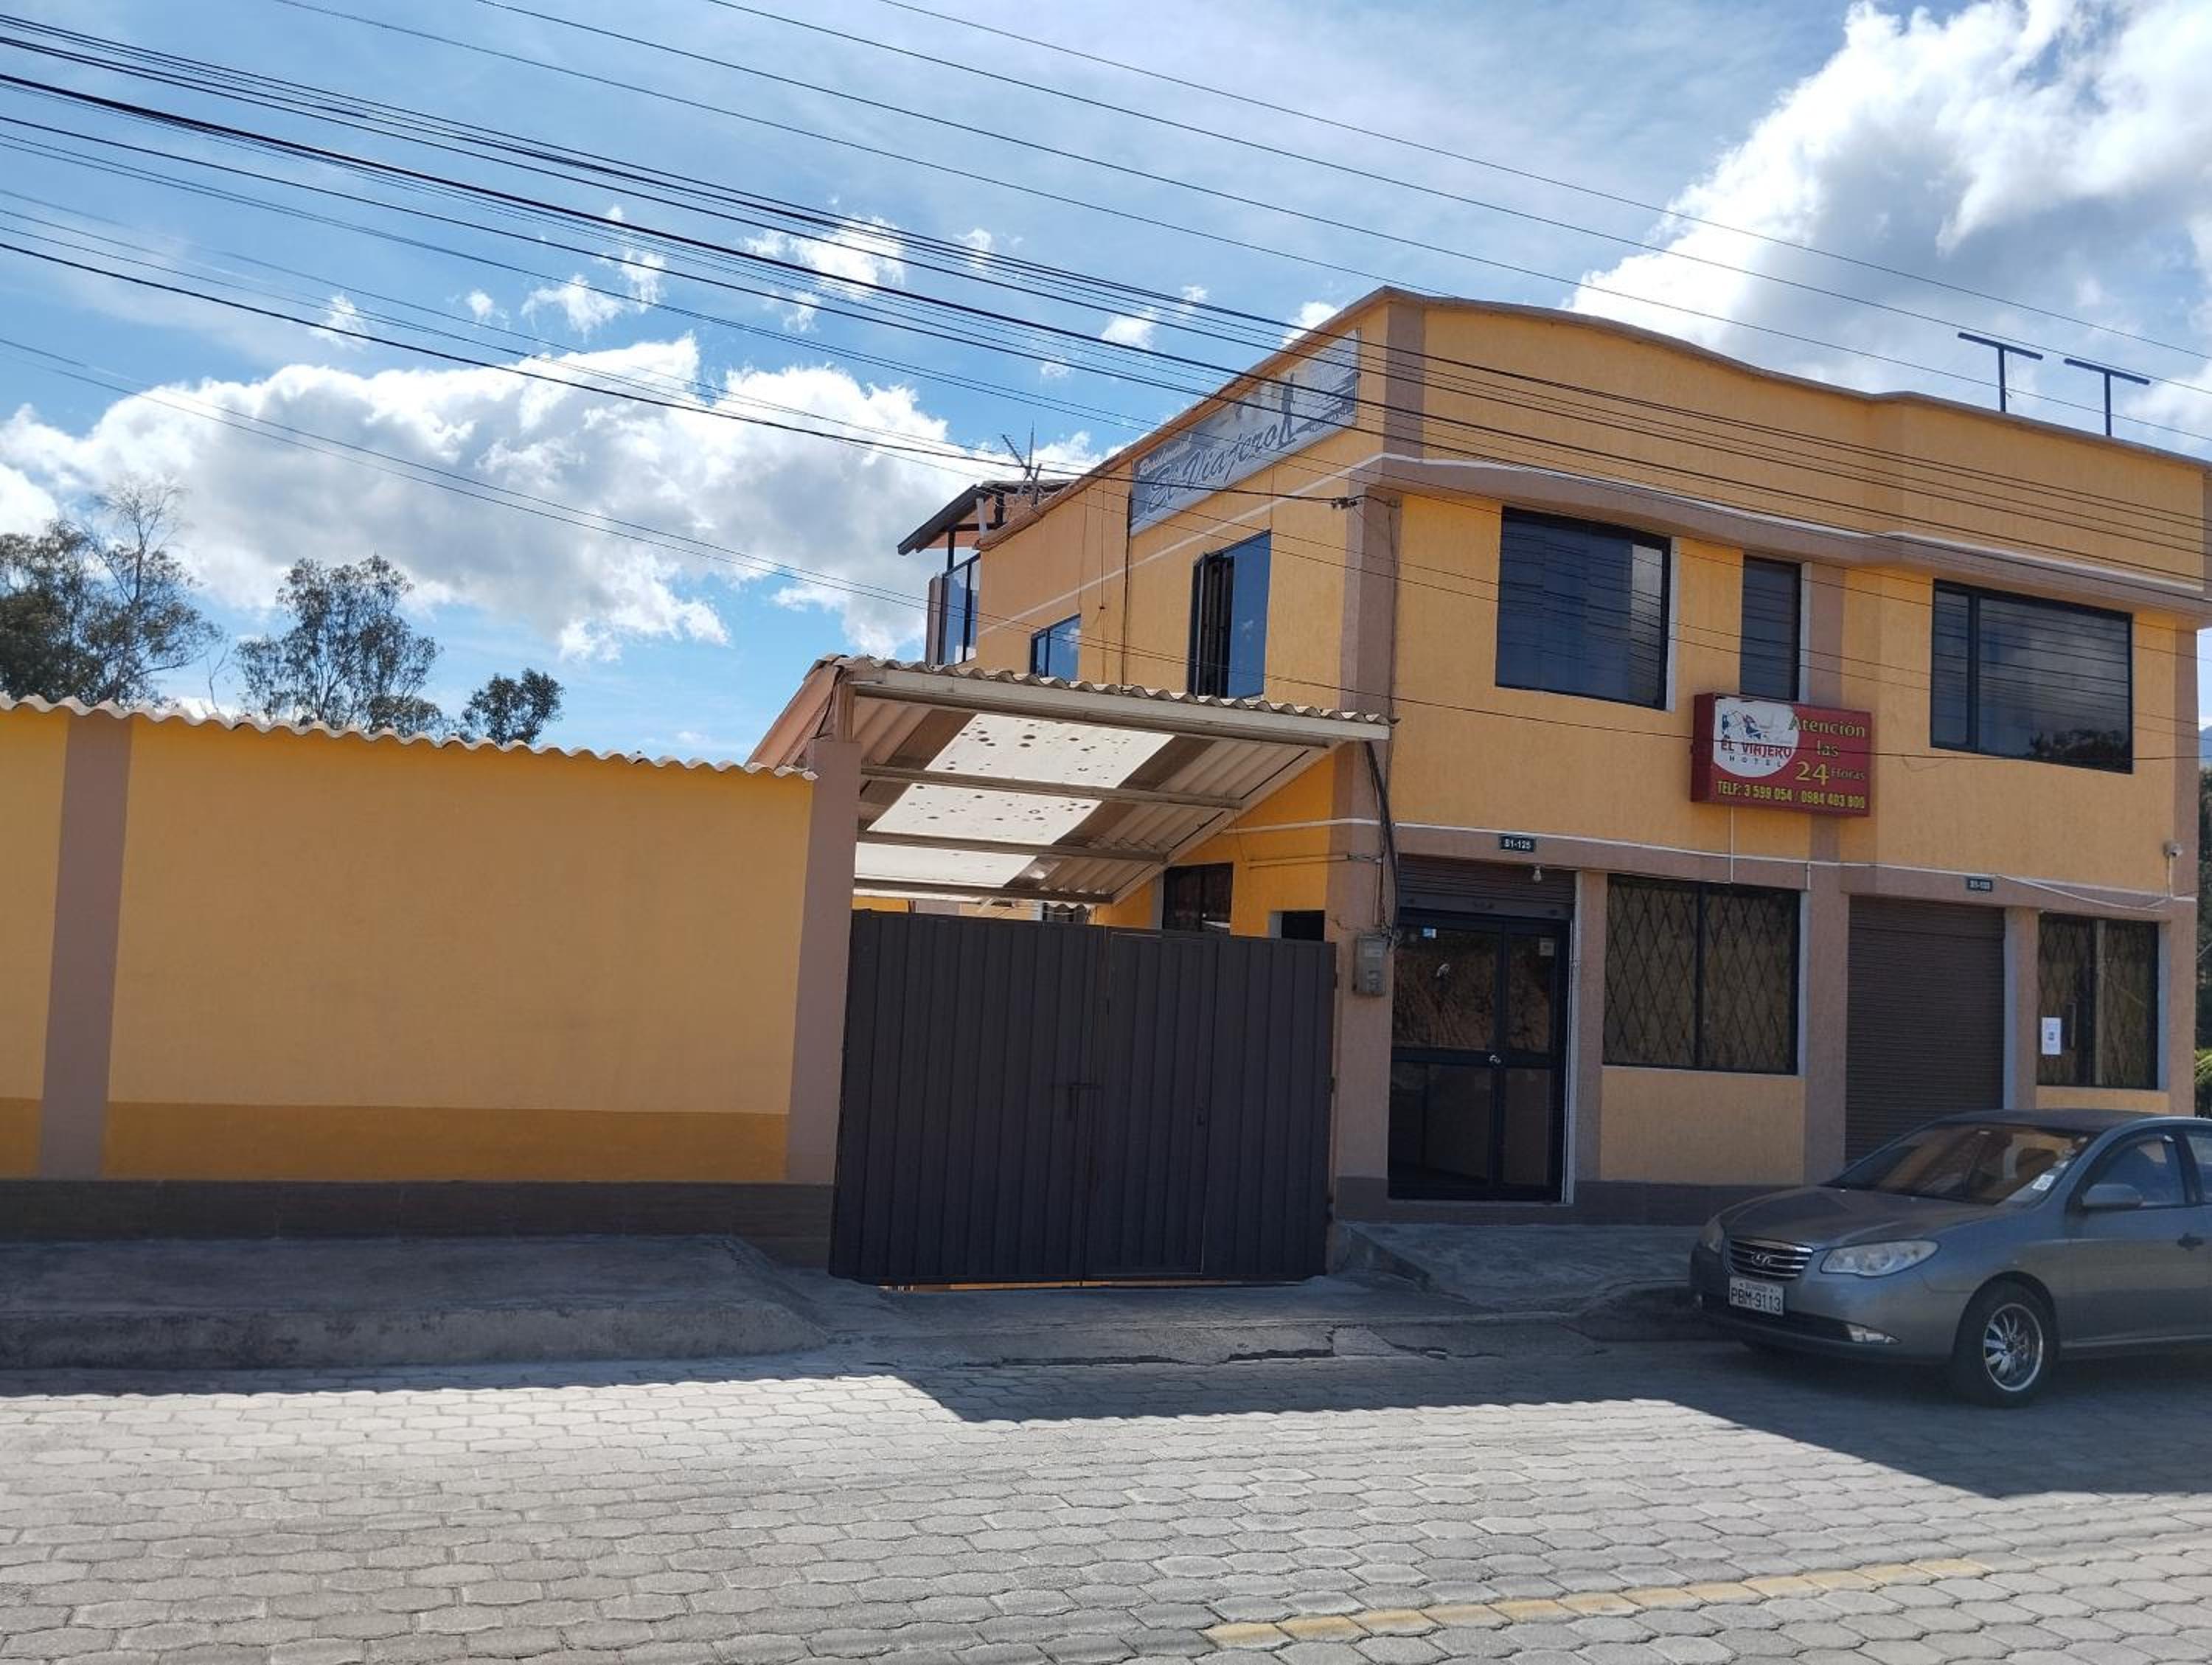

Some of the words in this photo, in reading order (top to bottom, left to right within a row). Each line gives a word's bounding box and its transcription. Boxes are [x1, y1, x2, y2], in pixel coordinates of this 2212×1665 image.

[1182, 423, 1278, 492] Viajero
[1788, 715, 1865, 737] Atención
[1721, 740, 1735, 752] EL
[1742, 742, 1792, 759] VIAJERO
[1817, 740, 1840, 758] las
[1729, 754, 1782, 768] HOTEL
[1795, 760, 1829, 786] 24
[1830, 768, 1865, 779] Horas
[1744, 784, 1751, 797] 3
[1731, 1286, 1781, 1313] PBM-9113
